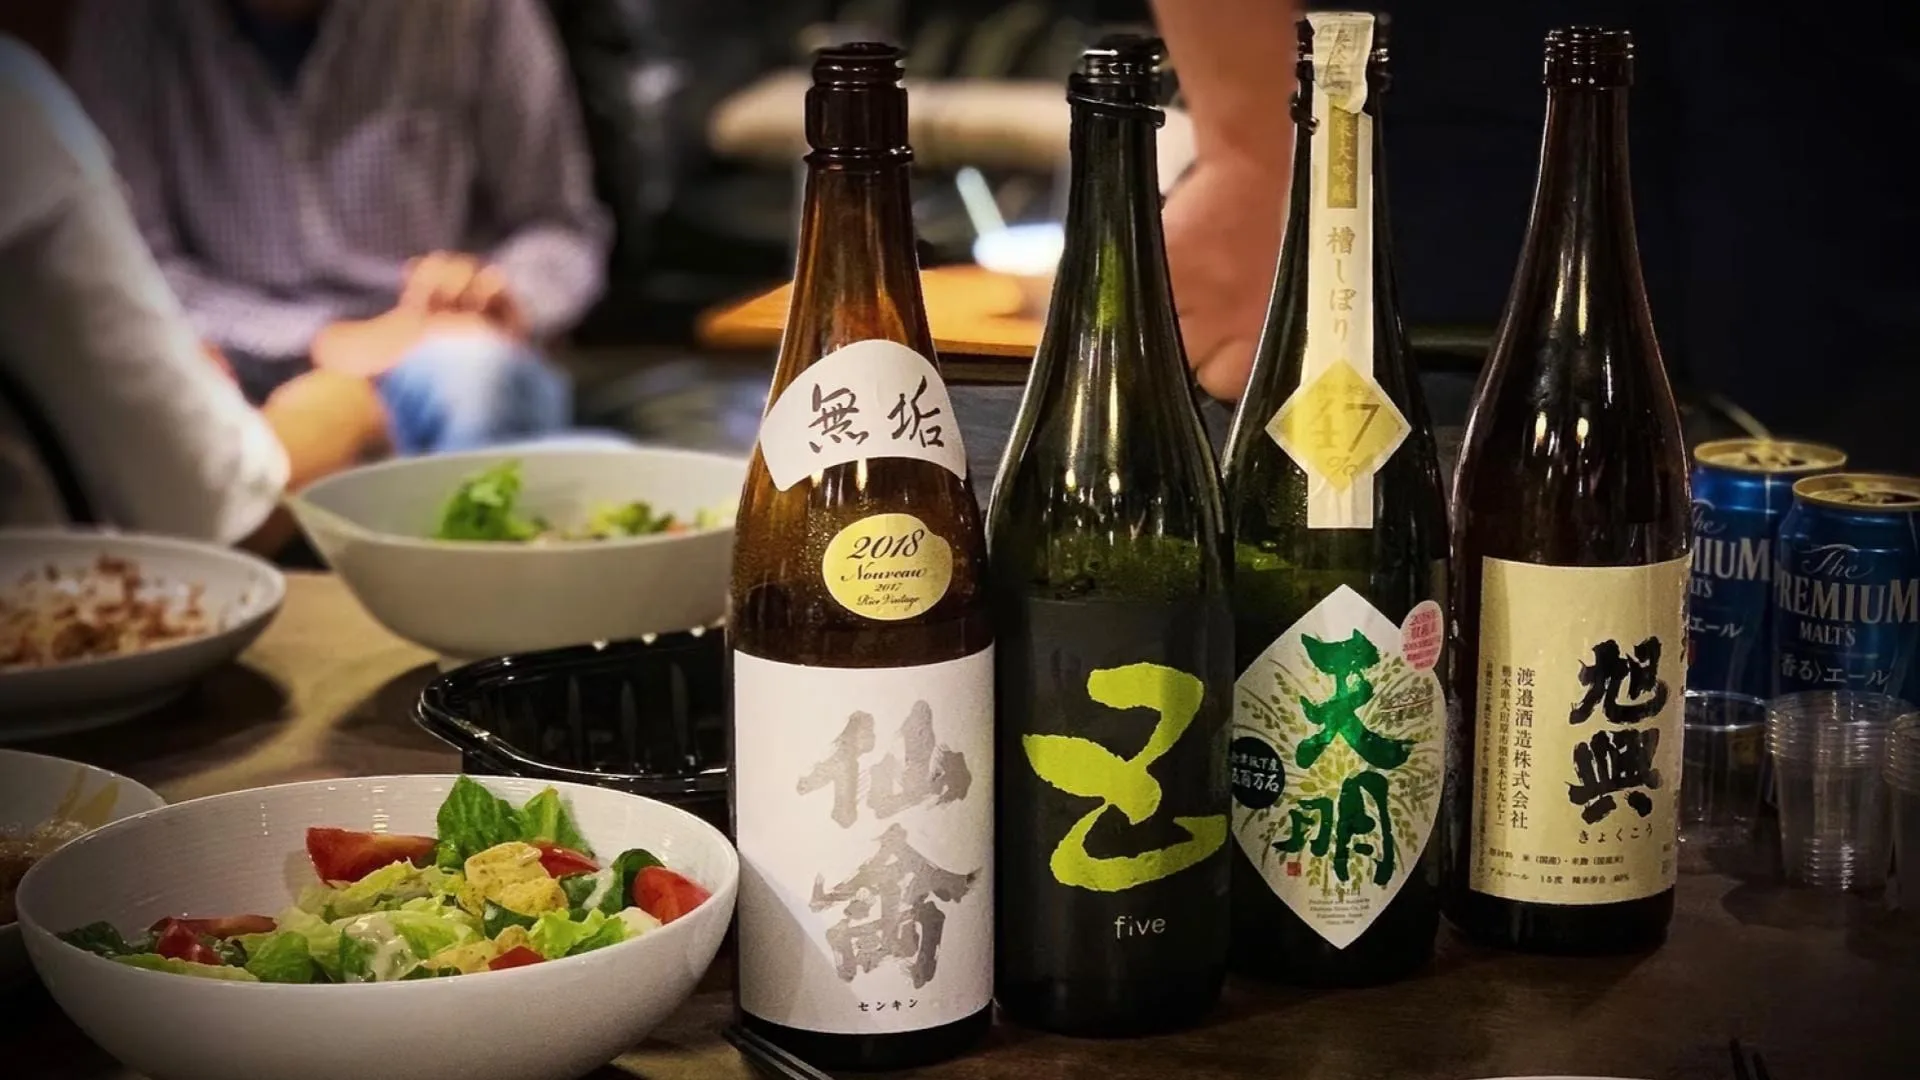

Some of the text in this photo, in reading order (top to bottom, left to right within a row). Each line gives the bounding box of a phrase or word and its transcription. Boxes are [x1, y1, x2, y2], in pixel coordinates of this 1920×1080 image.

[1326, 226, 1357, 342] 槽しぼり
[808, 375, 945, 454] 無垢
[846, 529, 925, 560] 2018
[841, 561, 928, 582] Nouveau
[1801, 544, 1874, 580] The
[874, 582, 903, 592] 2017
[1566, 635, 1671, 826] 旭興
[1272, 628, 1418, 886] 天明
[1578, 823, 1653, 845] きょくこう
[1114, 915, 1167, 938] five
[857, 997, 919, 1012] センキン
